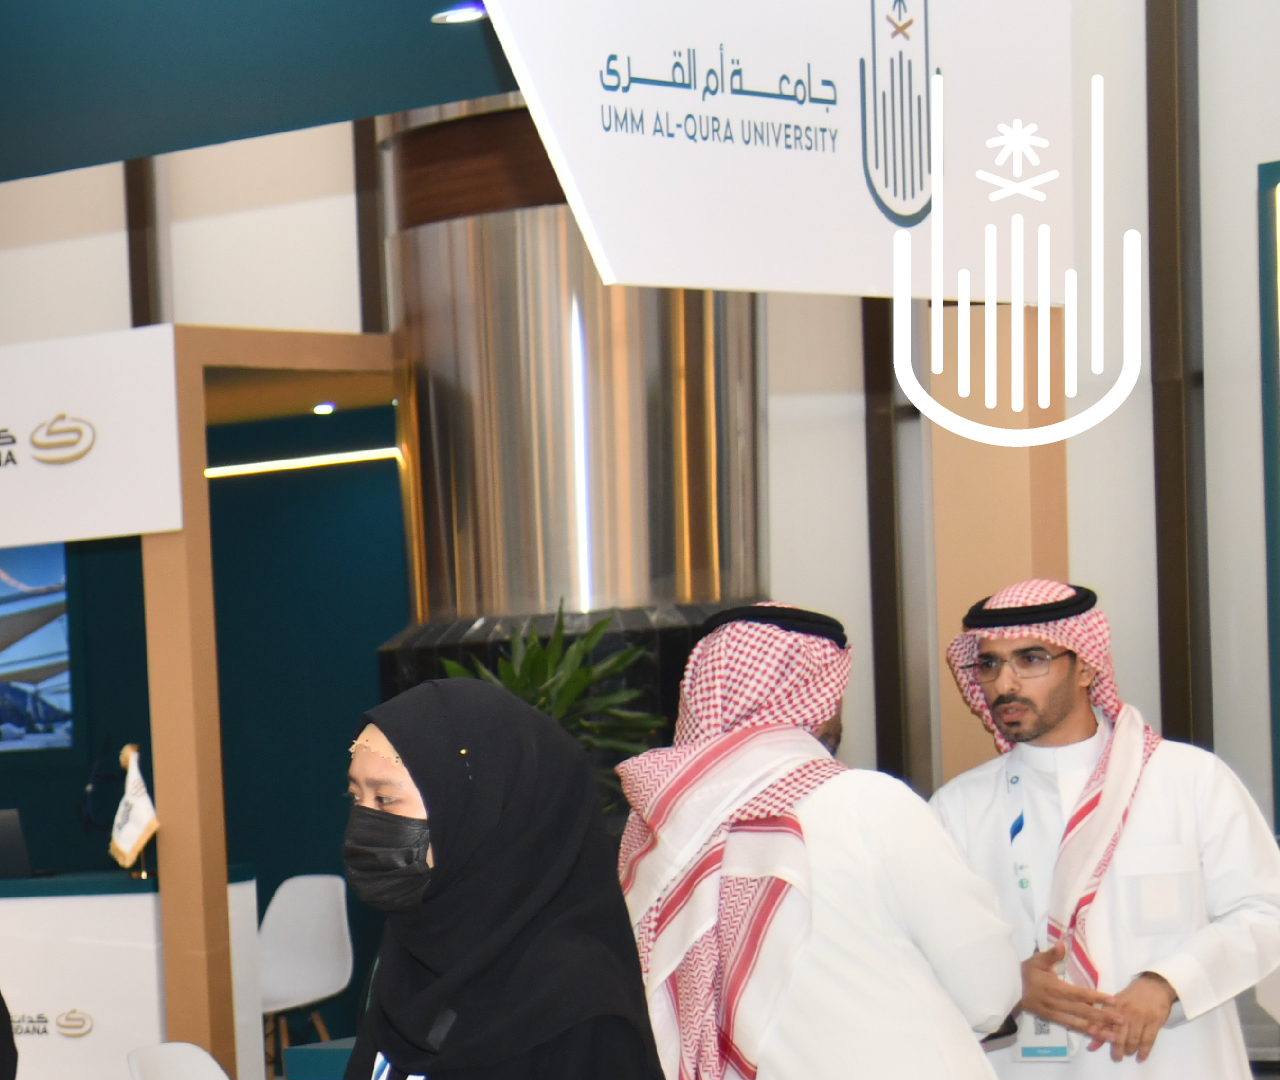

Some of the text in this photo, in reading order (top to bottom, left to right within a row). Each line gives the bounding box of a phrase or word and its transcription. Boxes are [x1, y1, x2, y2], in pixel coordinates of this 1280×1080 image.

[599, 43, 838, 113] جامعة أم القرى
[600, 104, 838, 153] UMM AL-QURA UNIVERSITY
